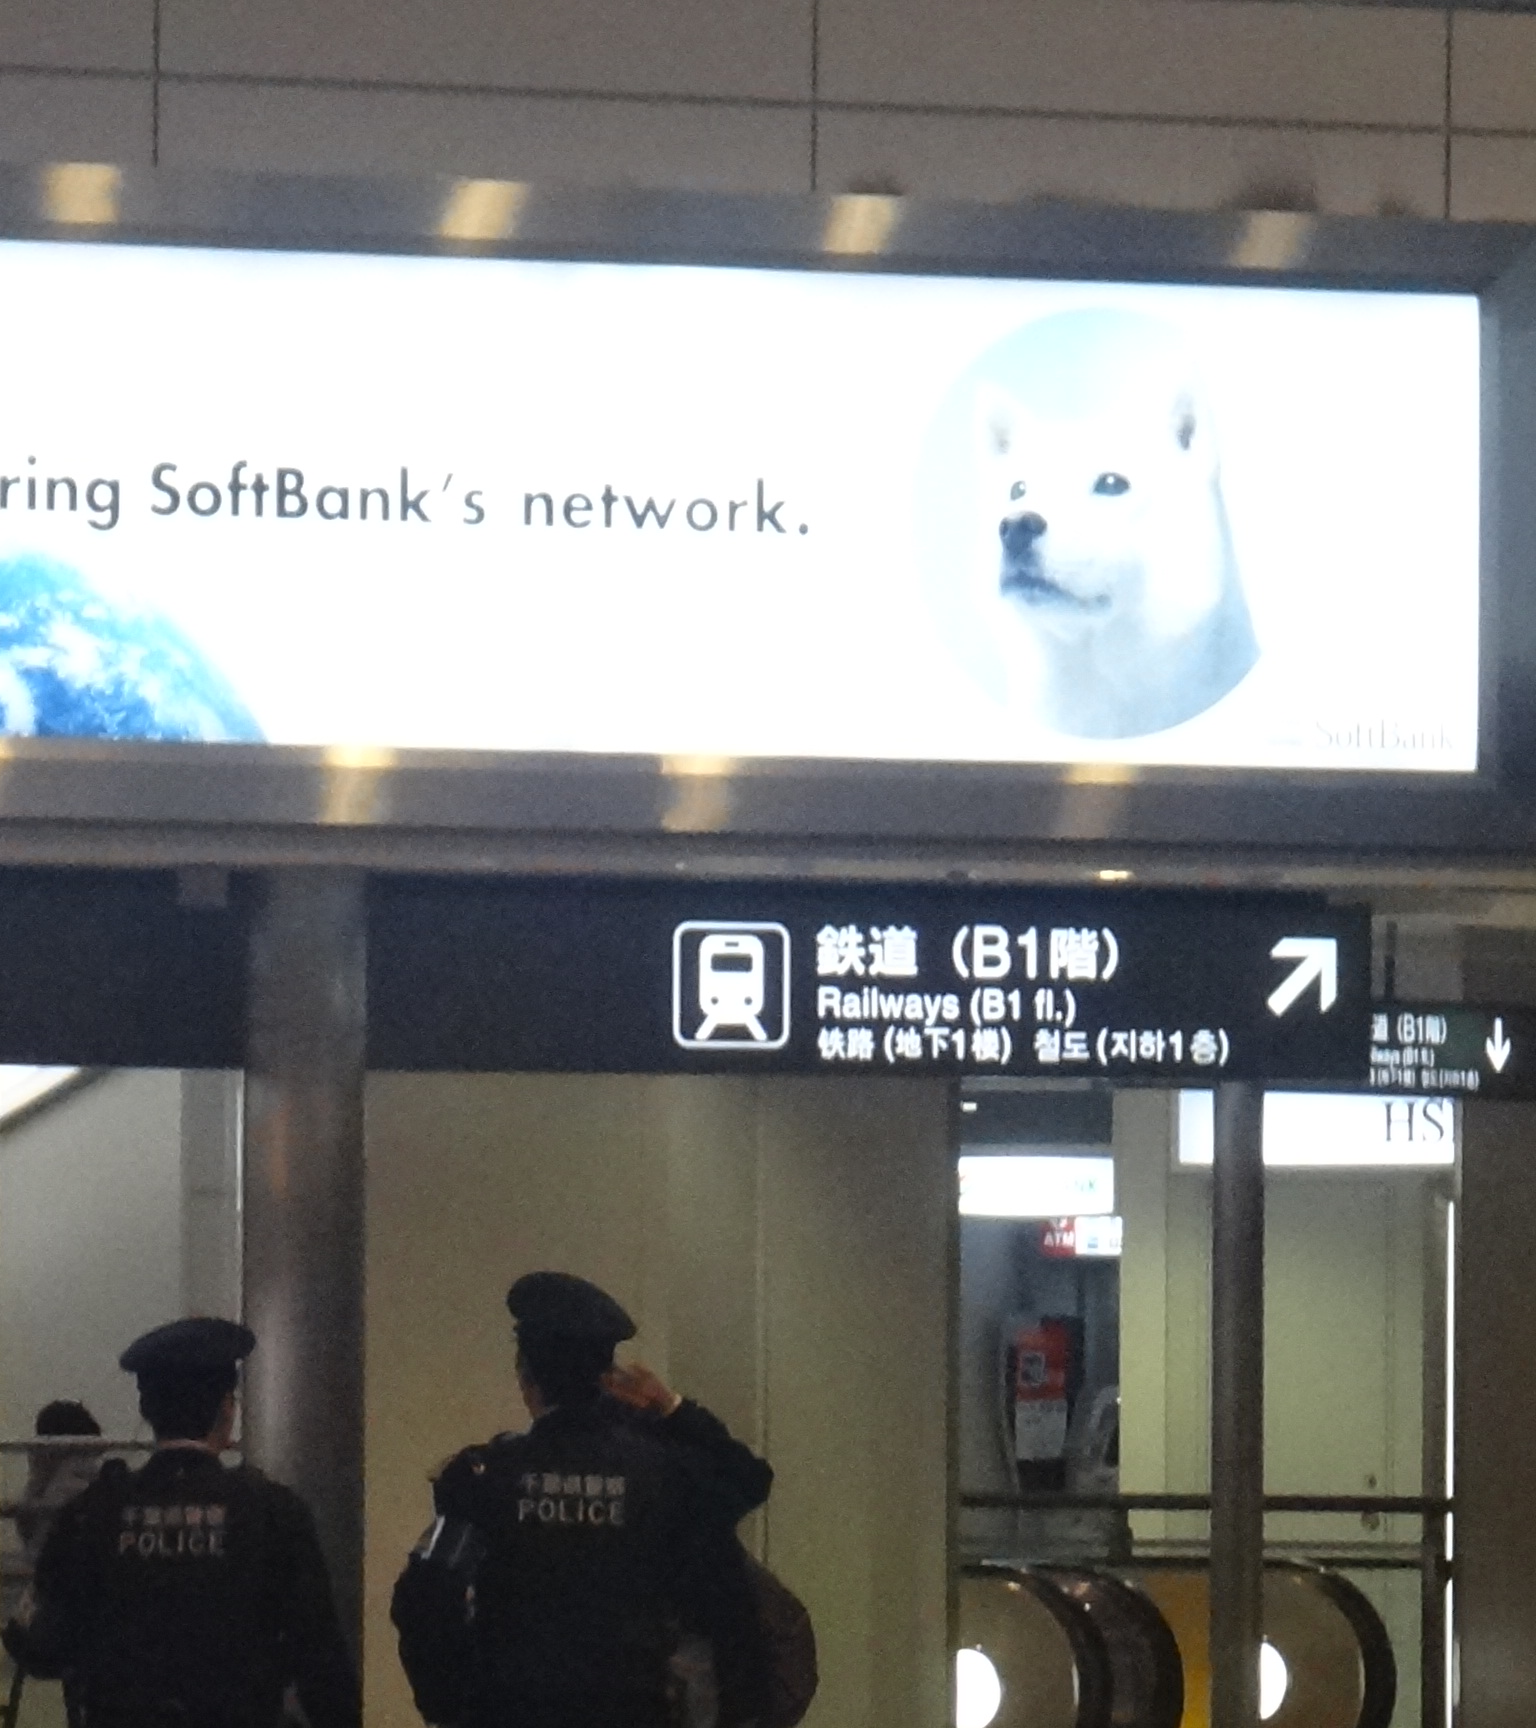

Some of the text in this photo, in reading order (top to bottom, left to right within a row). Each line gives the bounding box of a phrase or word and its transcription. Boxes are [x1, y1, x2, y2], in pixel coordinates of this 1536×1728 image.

[150, 459, 486, 525] SoftBank's
[523, 477, 810, 536] network.
[816, 924, 919, 976] 鉄道
[817, 985, 1077, 1028] Railways (B1 fl.)
[517, 1498, 625, 1526] POLICE
[118, 1530, 226, 1558] POLICE
